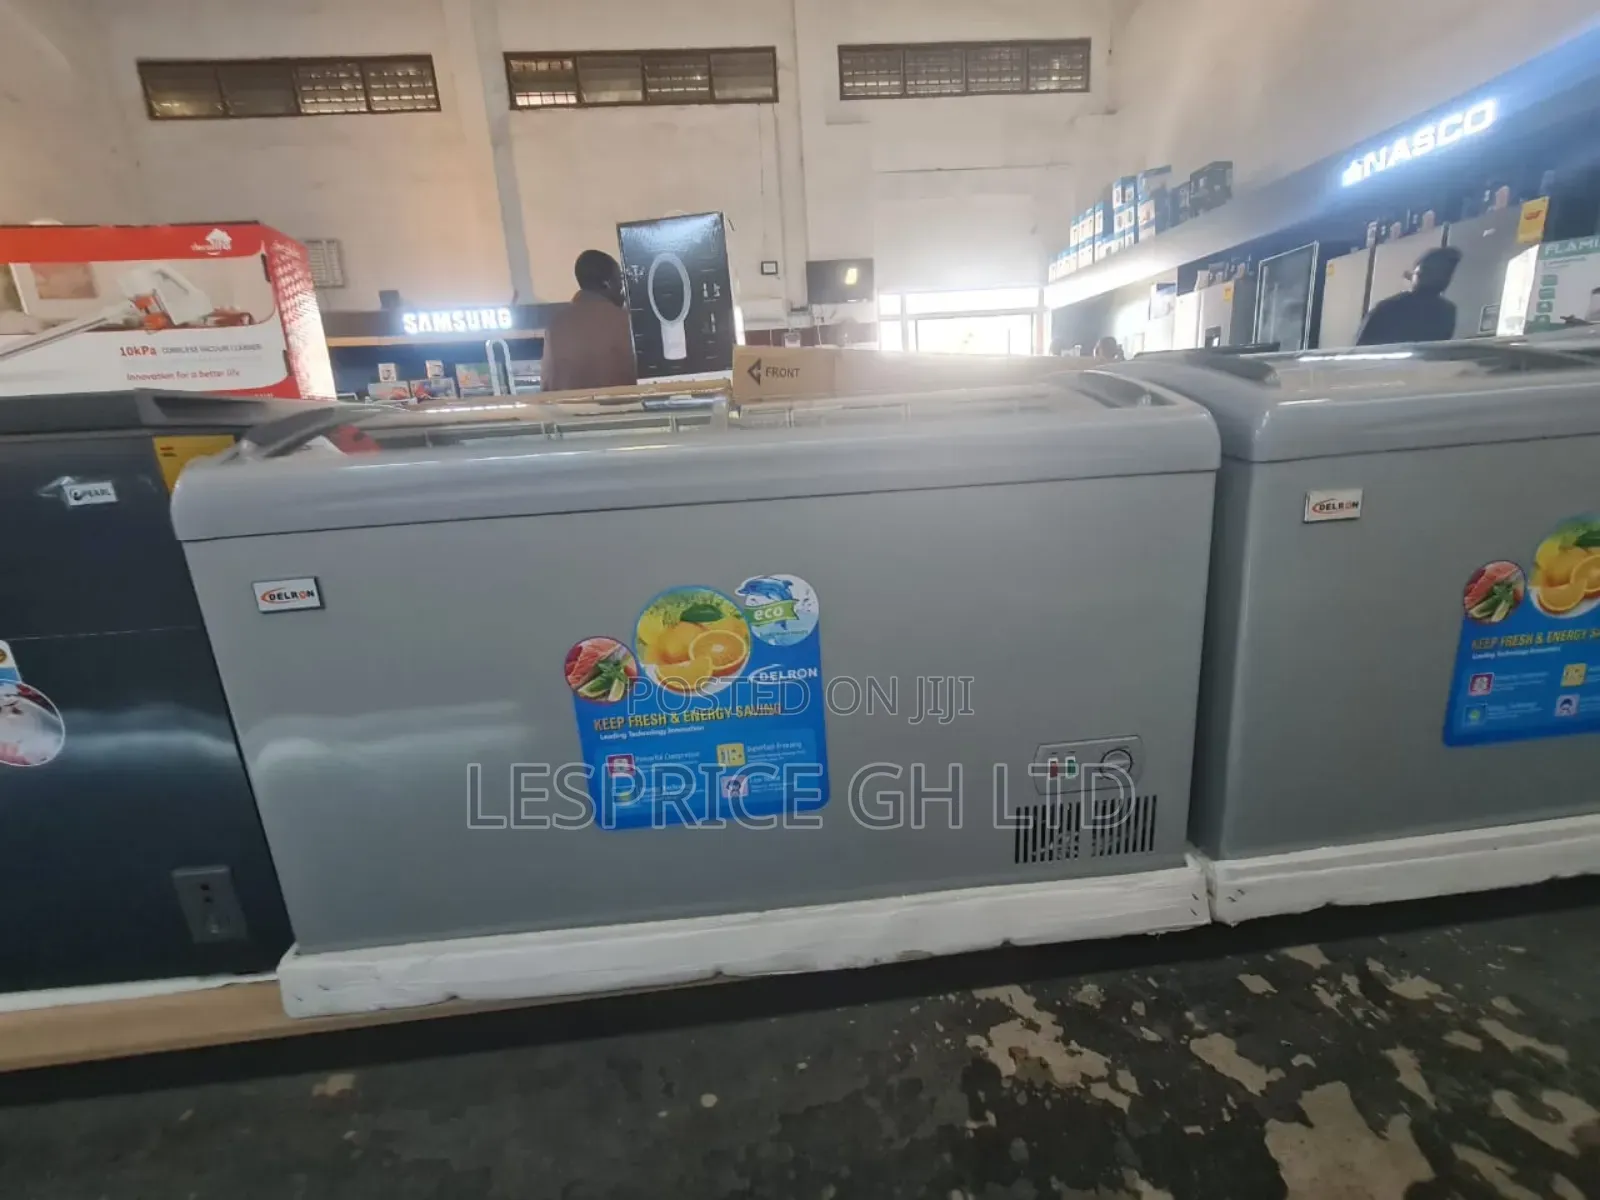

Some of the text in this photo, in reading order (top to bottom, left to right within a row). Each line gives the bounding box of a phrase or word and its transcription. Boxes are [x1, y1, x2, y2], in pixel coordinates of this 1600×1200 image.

[1362, 98, 1497, 178] NASCO
[404, 308, 512, 334] SAMSUNG
[119, 346, 157, 357] 10kPa
[176, 370, 188, 380] for
[765, 366, 801, 378] FRONT
[1319, 500, 1359, 512] DELRON
[268, 589, 315, 601] DELRON
[754, 606, 784, 620] eco
[759, 667, 818, 681] DELRON
[593, 717, 625, 732] KEEP
[628, 713, 667, 728] FRESH
[669, 711, 681, 724] &
[683, 707, 732, 722] ENERGY
